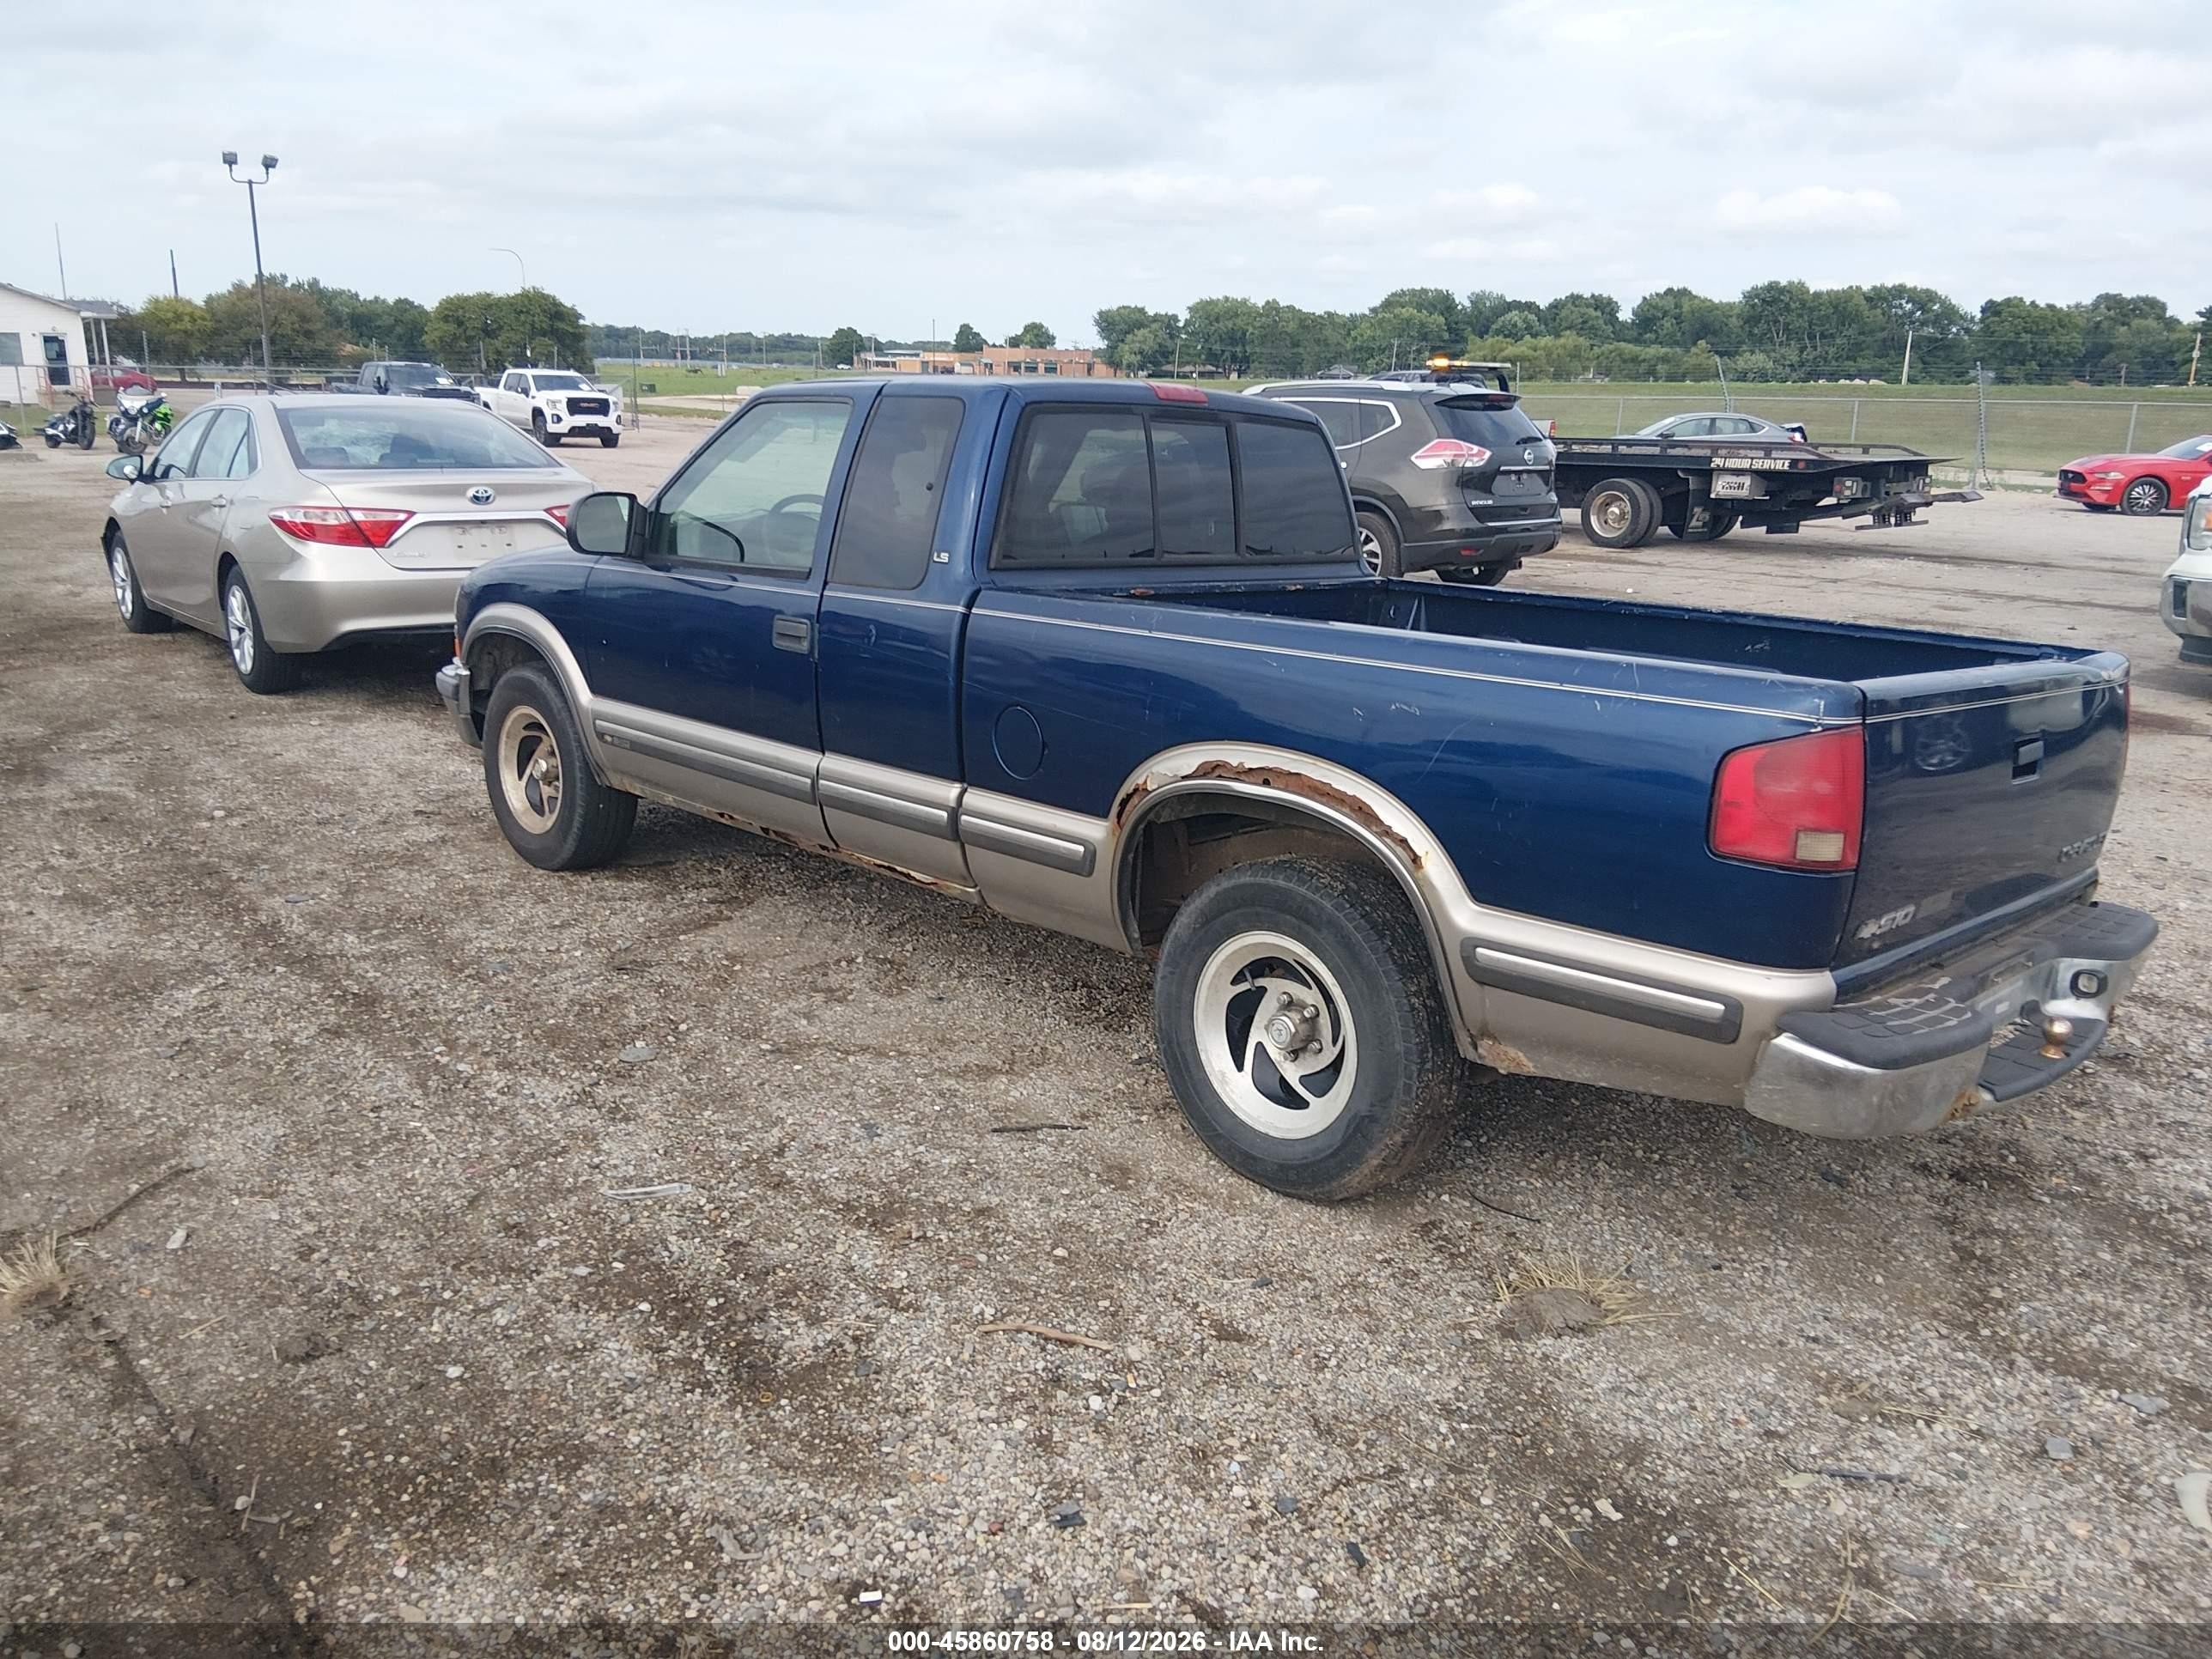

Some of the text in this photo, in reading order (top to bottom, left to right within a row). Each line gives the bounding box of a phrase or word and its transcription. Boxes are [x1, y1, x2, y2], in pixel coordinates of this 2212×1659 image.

[1711, 458, 1791, 470] 24 HOUR SERVICE
[933, 551, 949, 562] LS
[1875, 904, 1916, 935] S10
